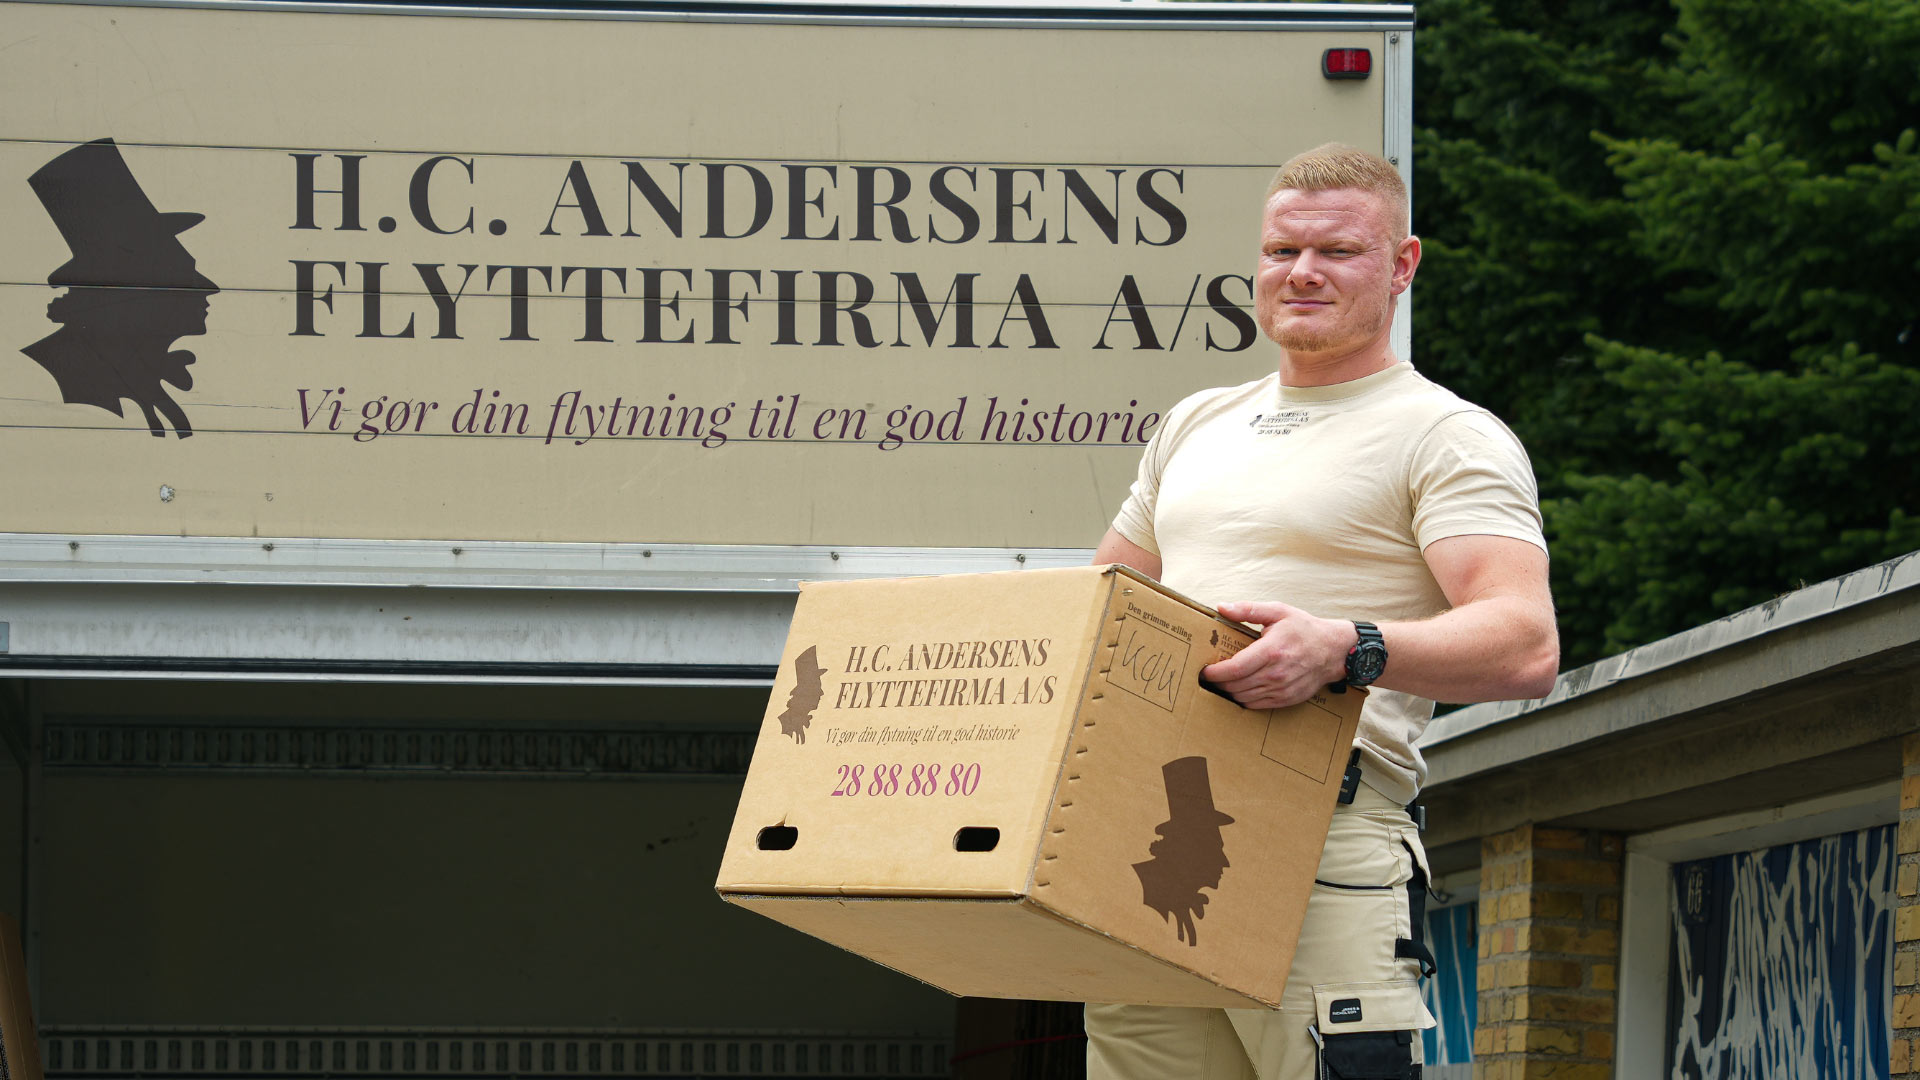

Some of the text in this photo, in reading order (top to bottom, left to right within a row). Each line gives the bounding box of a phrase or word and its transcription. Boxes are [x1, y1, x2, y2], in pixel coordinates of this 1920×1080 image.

[288, 153, 1188, 247] H.C. ANDERSENS
[288, 260, 1258, 353] FLYTTEFIRMA A/S
[296, 387, 1160, 451] Vi gør din flytning til en god historie
[1127, 601, 1193, 642] Den grimme ælling
[844, 638, 1052, 673] H.C. ANDERSENS
[834, 675, 1058, 710] FLYTTEFIRMA A/S
[826, 724, 1021, 747] Vi gør din flytning til en god historie
[831, 762, 982, 797] 28 88 88 80
